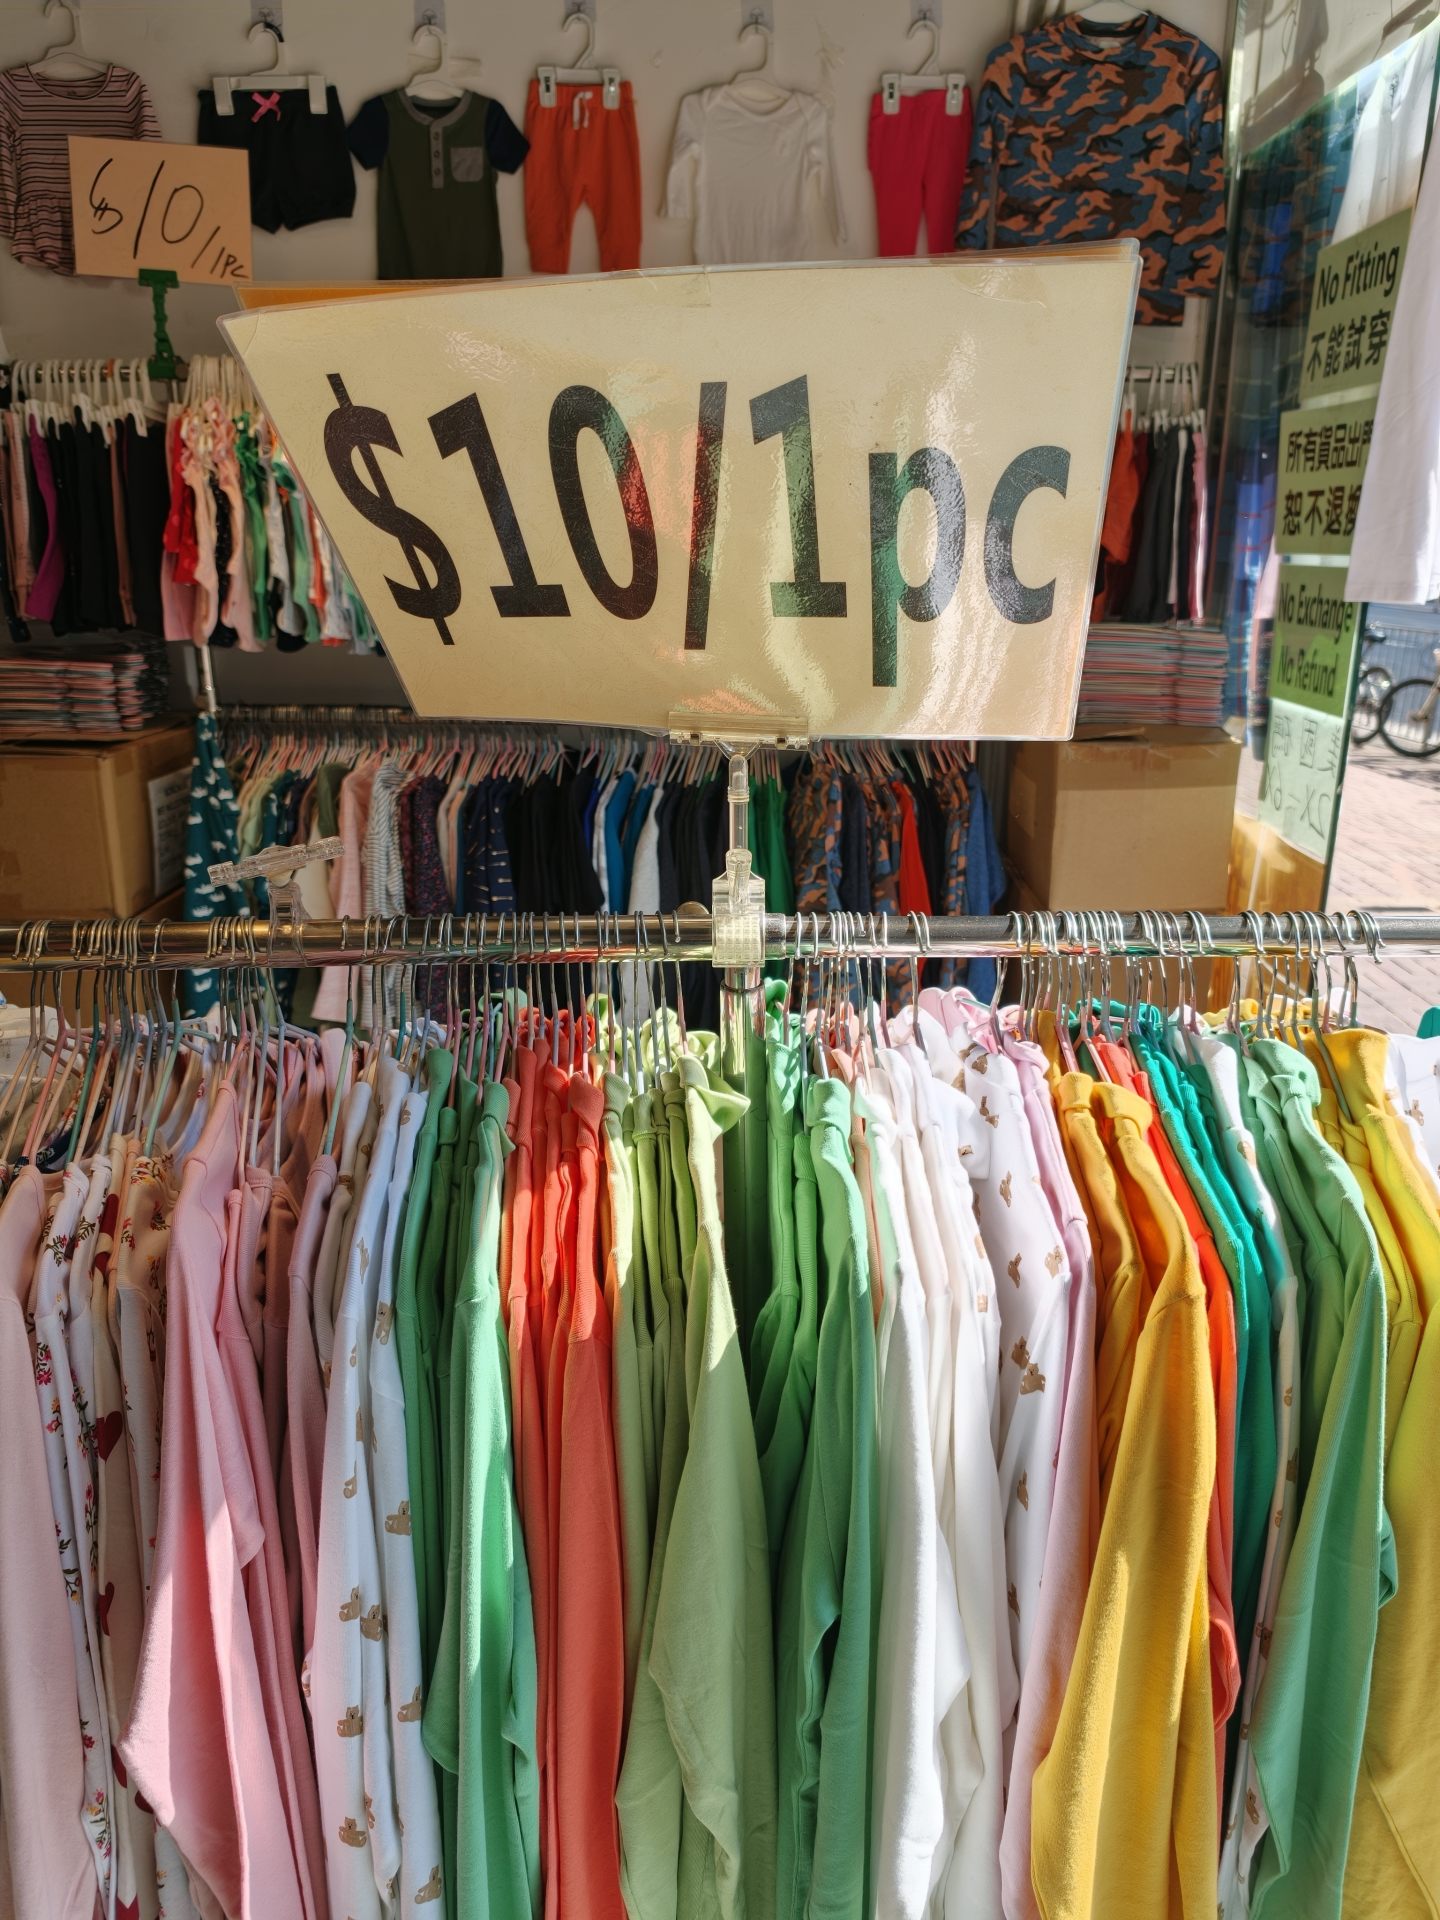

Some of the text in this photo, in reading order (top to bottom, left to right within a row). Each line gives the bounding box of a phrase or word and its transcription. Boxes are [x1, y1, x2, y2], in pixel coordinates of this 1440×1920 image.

[1315, 241, 1400, 311] No Fitting
[1306, 308, 1392, 383] 不能試穿
[323, 373, 1072, 688] $10/1pc
[1279, 582, 1354, 645] No Exchange
[1277, 645, 1340, 697] No Refund
